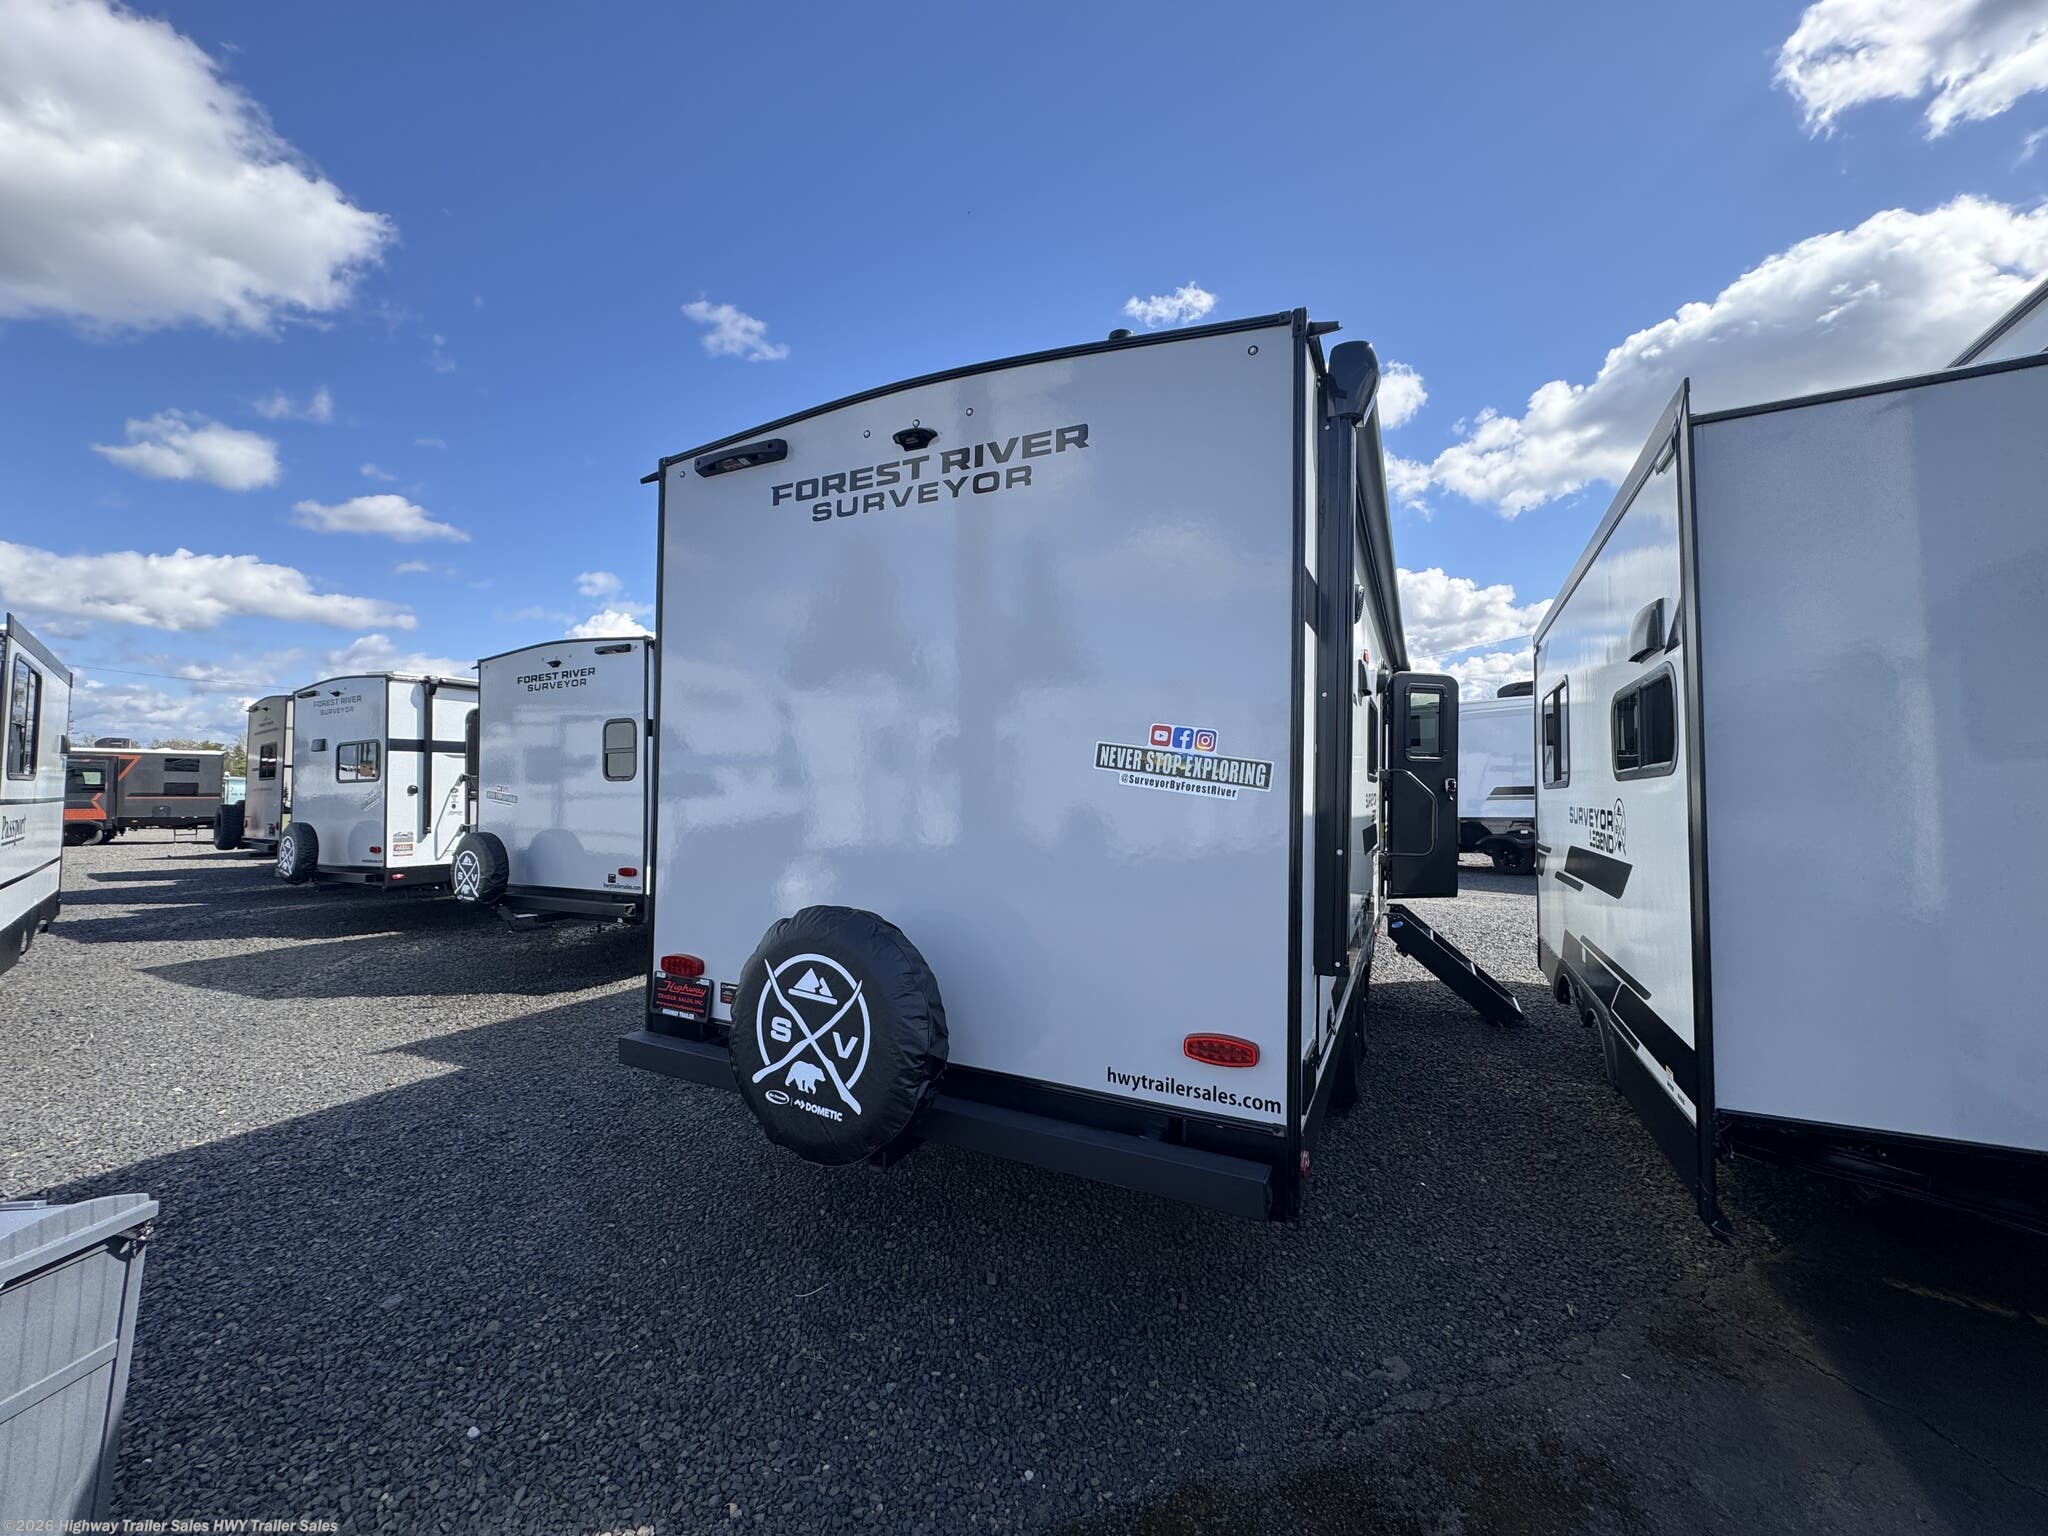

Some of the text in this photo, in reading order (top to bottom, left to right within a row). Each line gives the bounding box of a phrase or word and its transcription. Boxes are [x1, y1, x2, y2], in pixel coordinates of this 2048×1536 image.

[771, 423, 1090, 506] FOREST RIVER
[812, 465, 1033, 522] SURVEYOR
[517, 667, 596, 685] FOREST RIVER
[527, 678, 587, 692] SURVEYOR
[1099, 745, 1267, 788] NEVER STOP EXPLORING
[1120, 773, 1237, 798] @SurveyorByForestRiver
[1, 814, 26, 846] Passport
[1569, 805, 1614, 832] SURVEYOR
[1589, 829, 1614, 854] LEGEND
[657, 980, 707, 997] Highway
[770, 1016, 859, 1059] S V
[1106, 1066, 1282, 1114] hwytrailersales.com
[805, 1102, 843, 1122] DOMETIC
